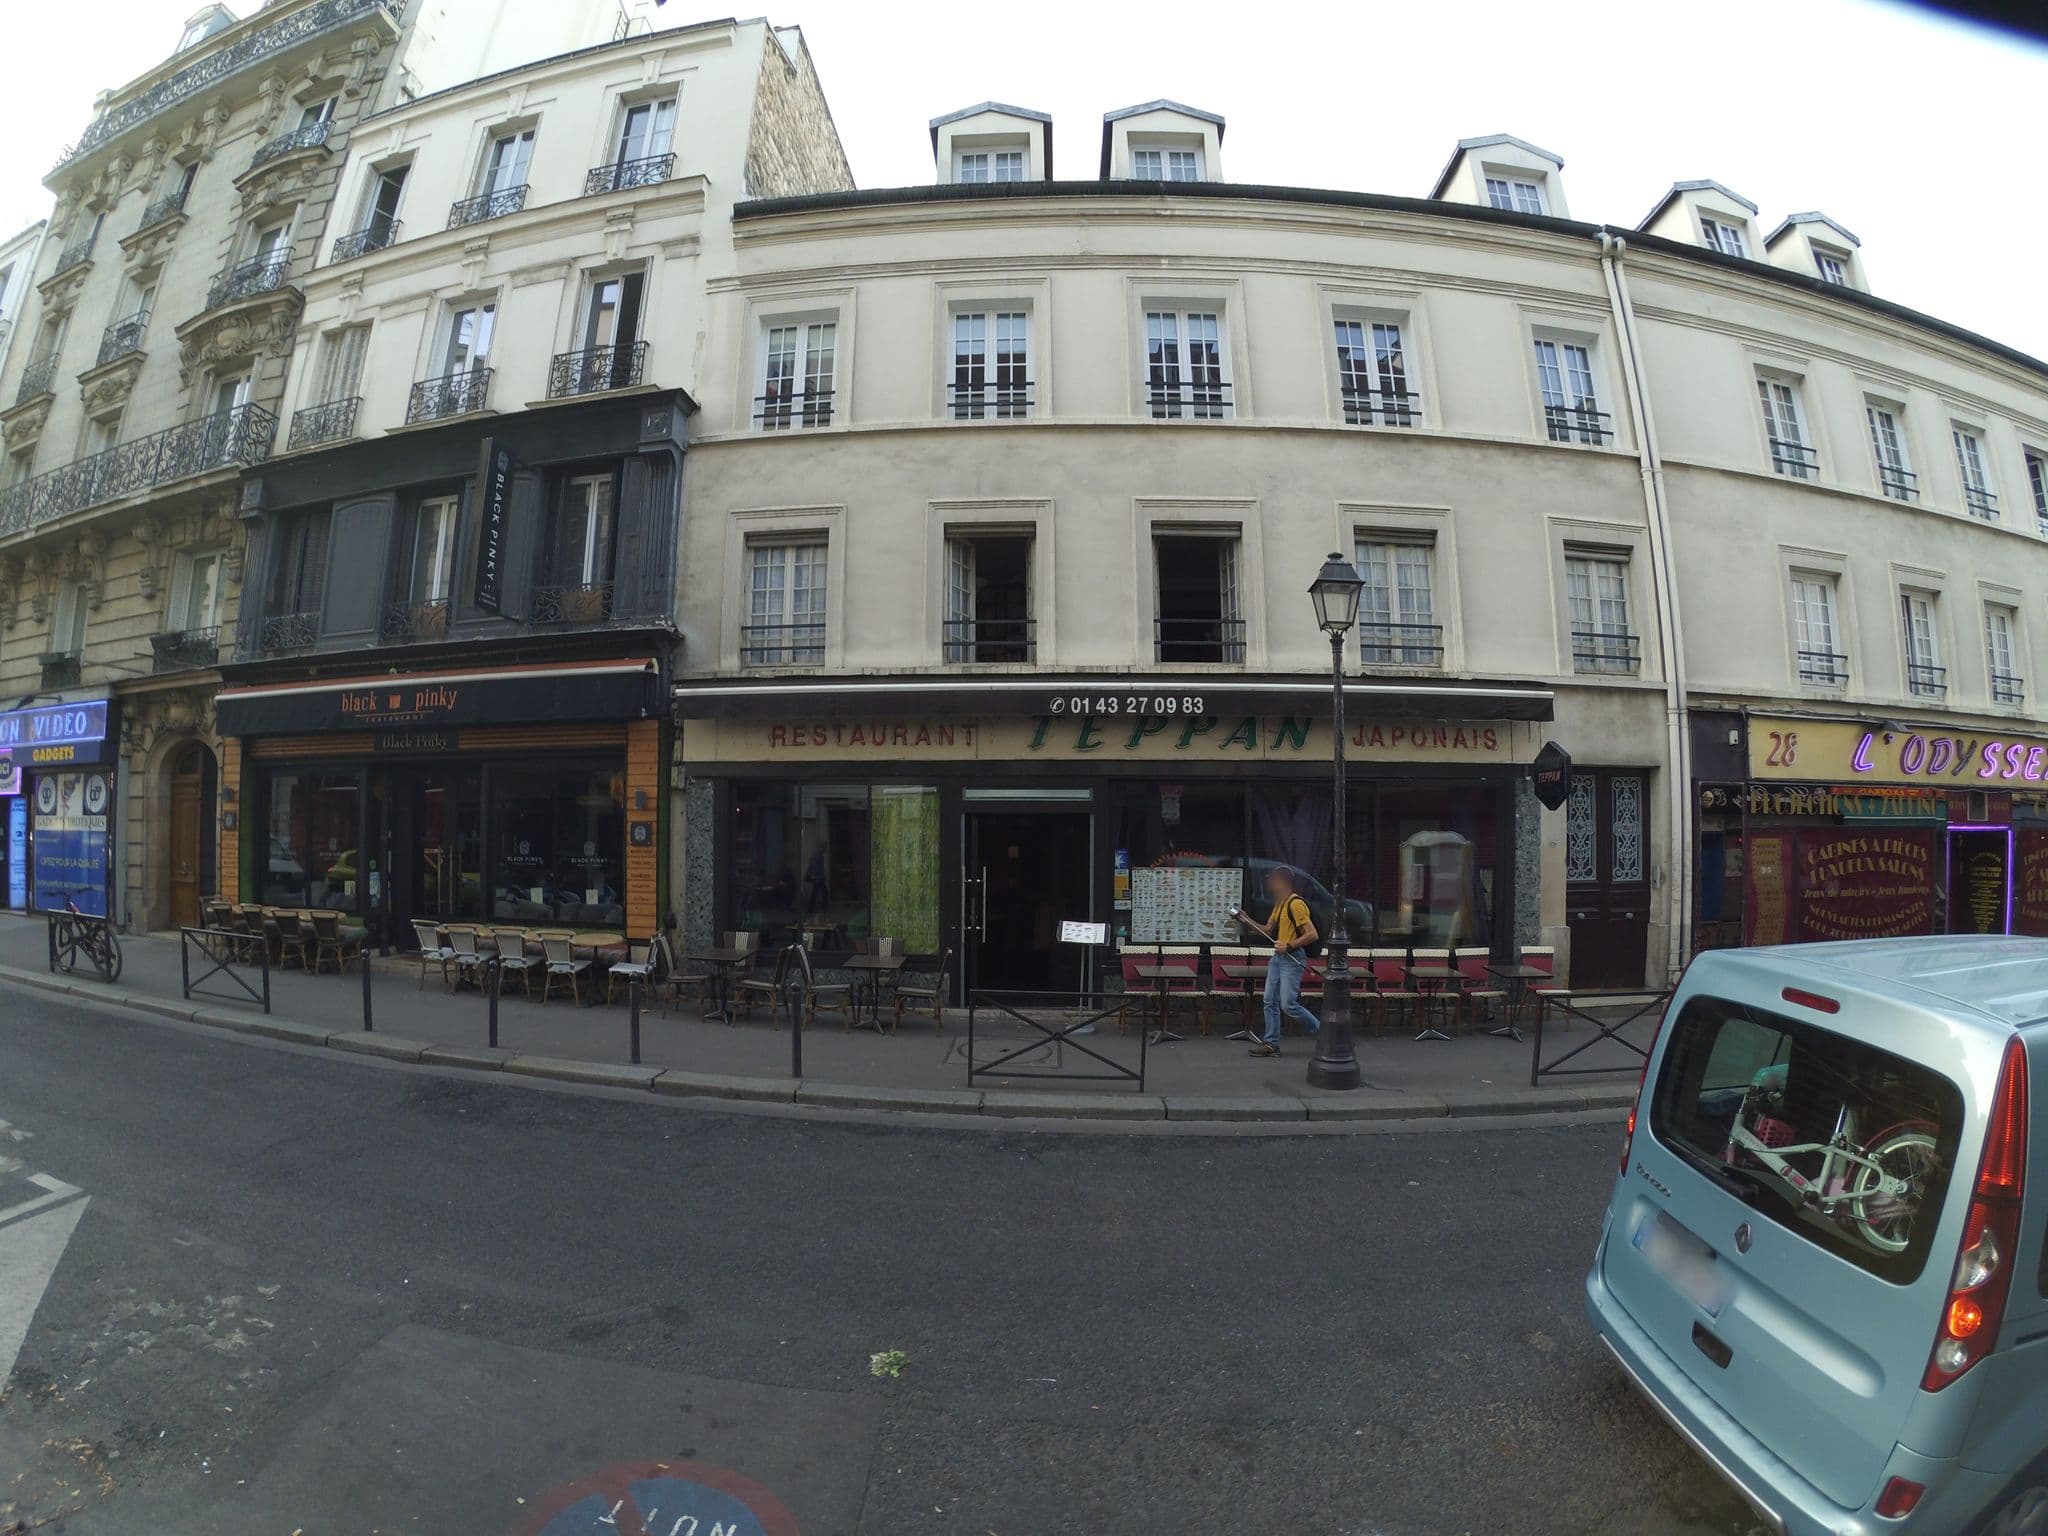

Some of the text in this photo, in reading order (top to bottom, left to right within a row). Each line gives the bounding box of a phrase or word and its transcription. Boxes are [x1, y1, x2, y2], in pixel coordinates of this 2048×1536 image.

[492, 473, 505, 524] BLACK
[487, 529, 499, 581] PINKY
[341, 685, 458, 713] black pinky
[1070, 697, 1204, 714] 01 43 27 09 83
[33, 711, 87, 738] VIDEO
[769, 714, 1499, 752] RESTAURANT TEPPAN JAPONAIS
[33, 746, 75, 762] GADGETS
[1766, 730, 1798, 767] 28
[1538, 770, 1561, 783] TEPPAN
